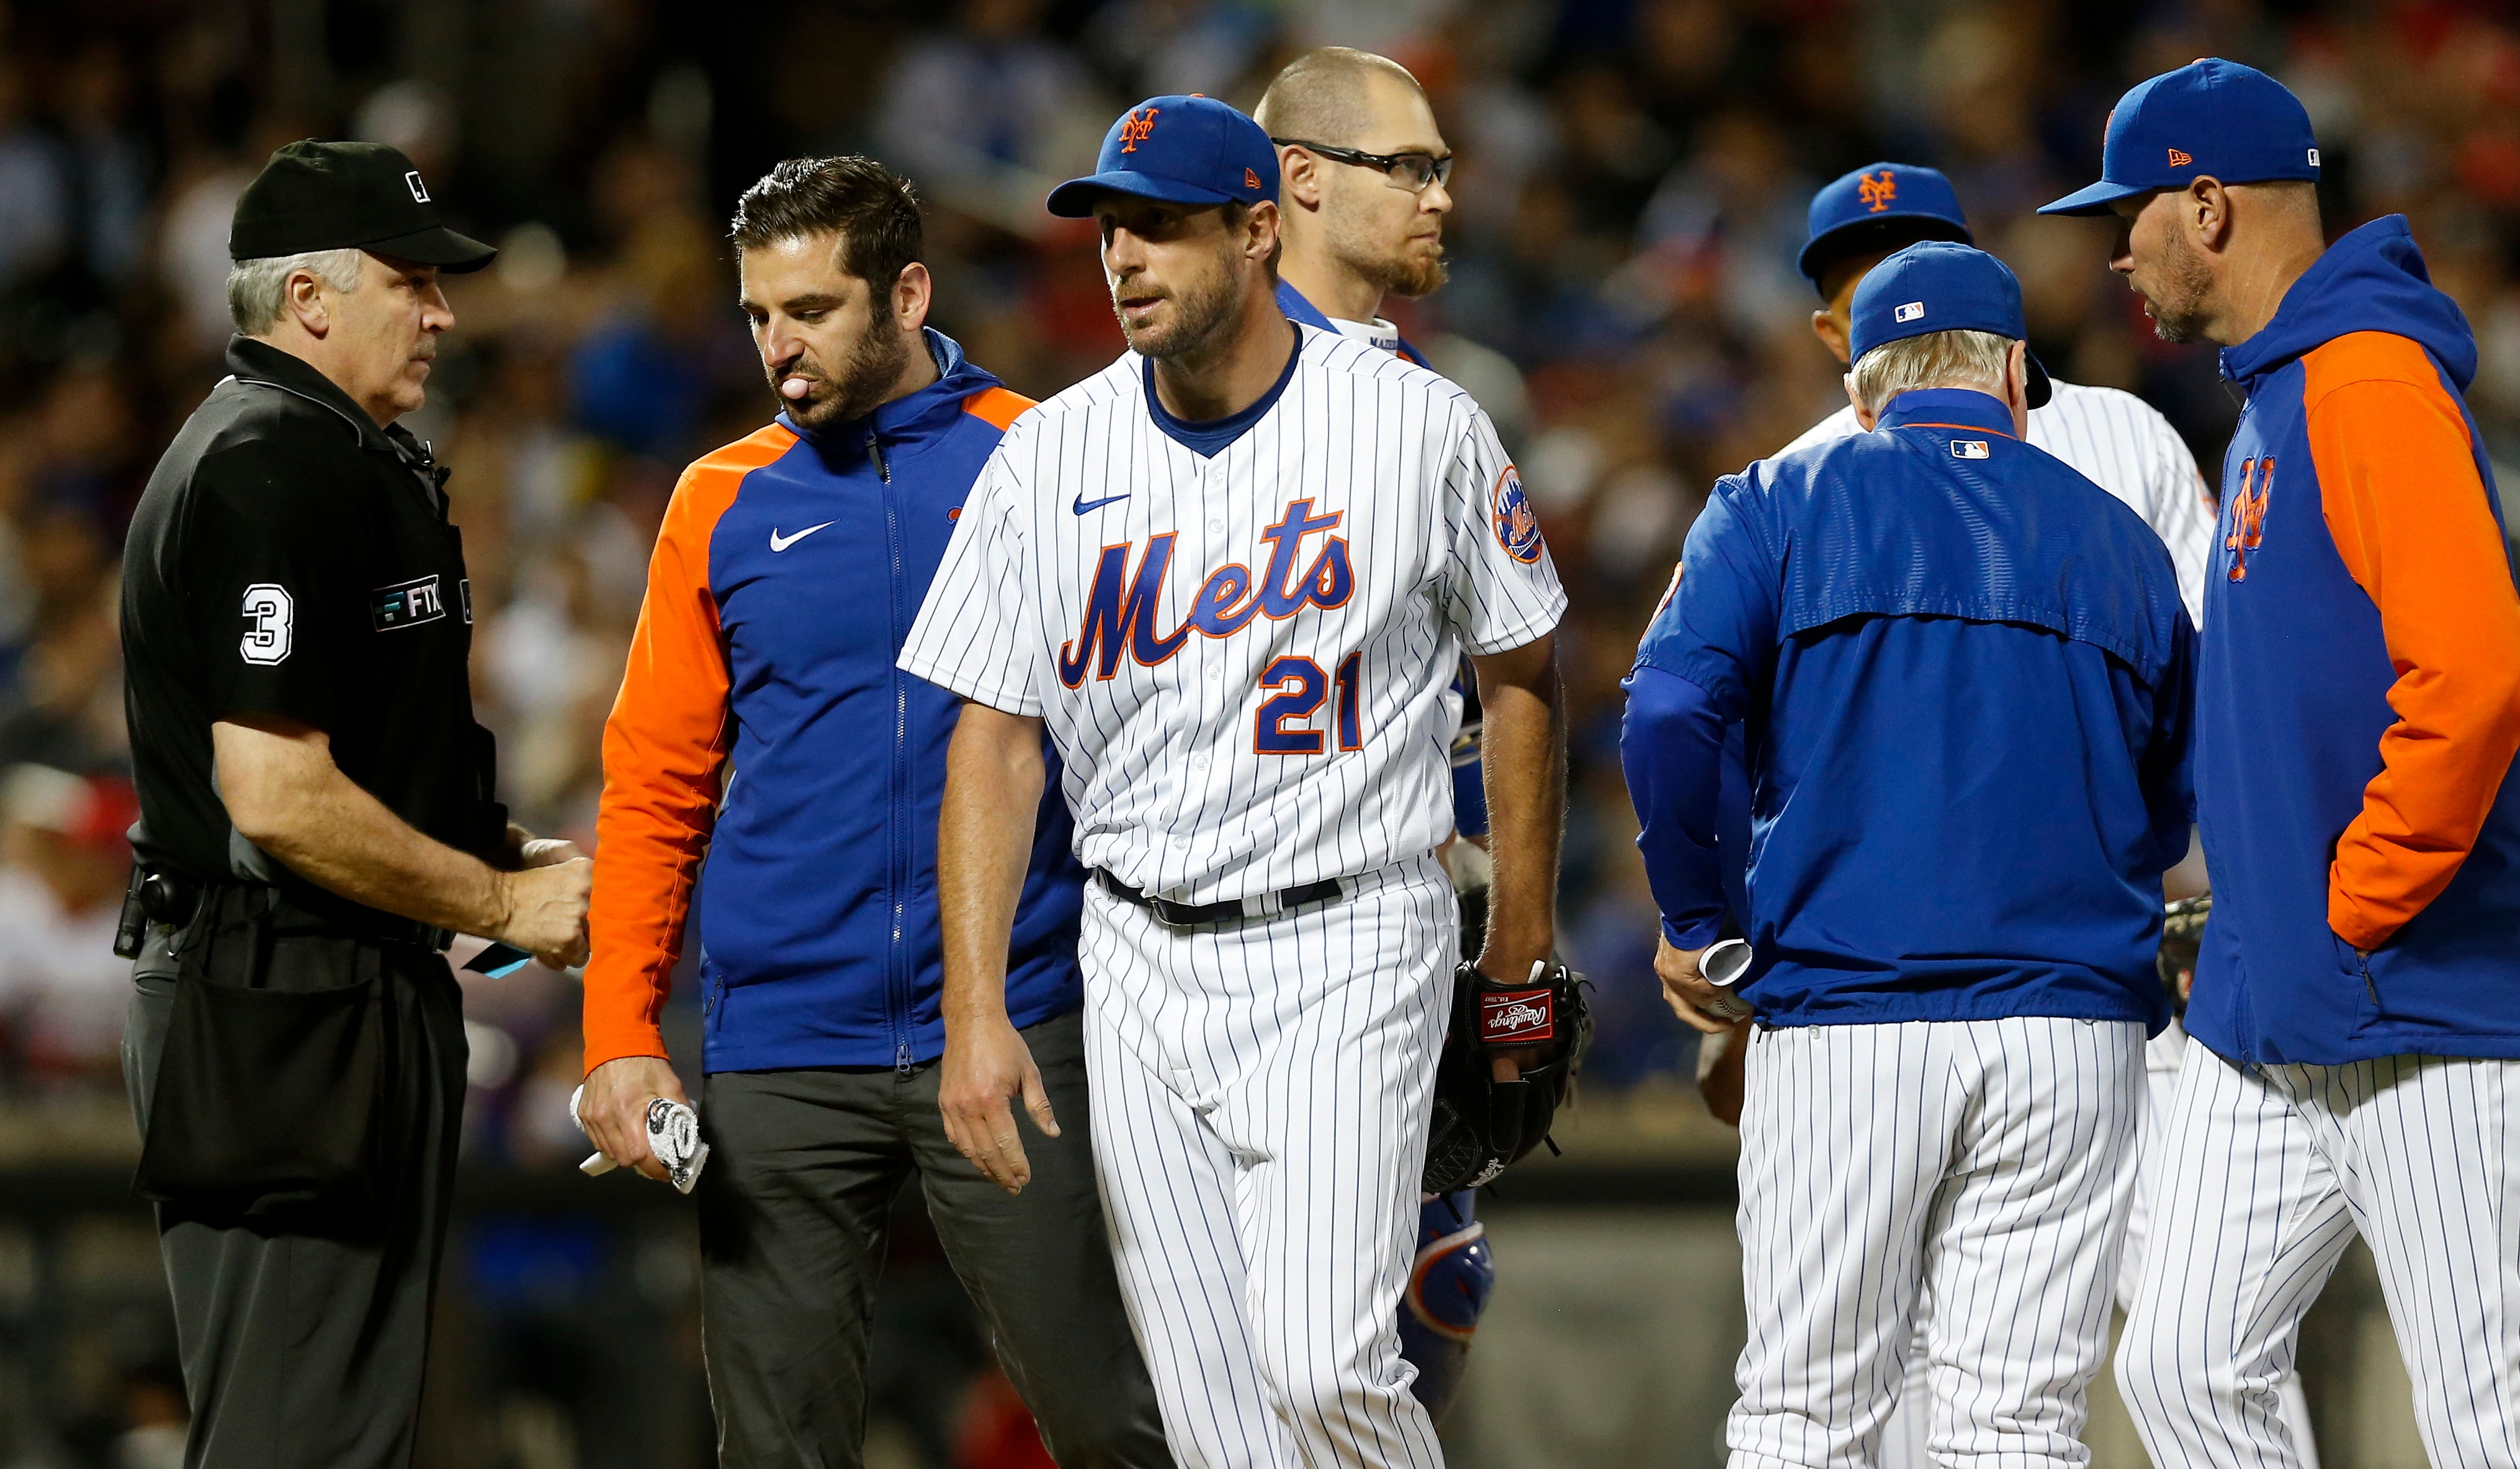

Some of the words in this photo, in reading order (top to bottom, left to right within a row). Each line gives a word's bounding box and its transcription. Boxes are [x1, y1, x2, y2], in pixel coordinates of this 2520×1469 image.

[240, 583, 294, 666] 3
[406, 583, 441, 618] FTX
[1058, 496, 1355, 690] Mets
[1253, 651, 1363, 755] 21
[1487, 1006, 1546, 1030] Rawlings
